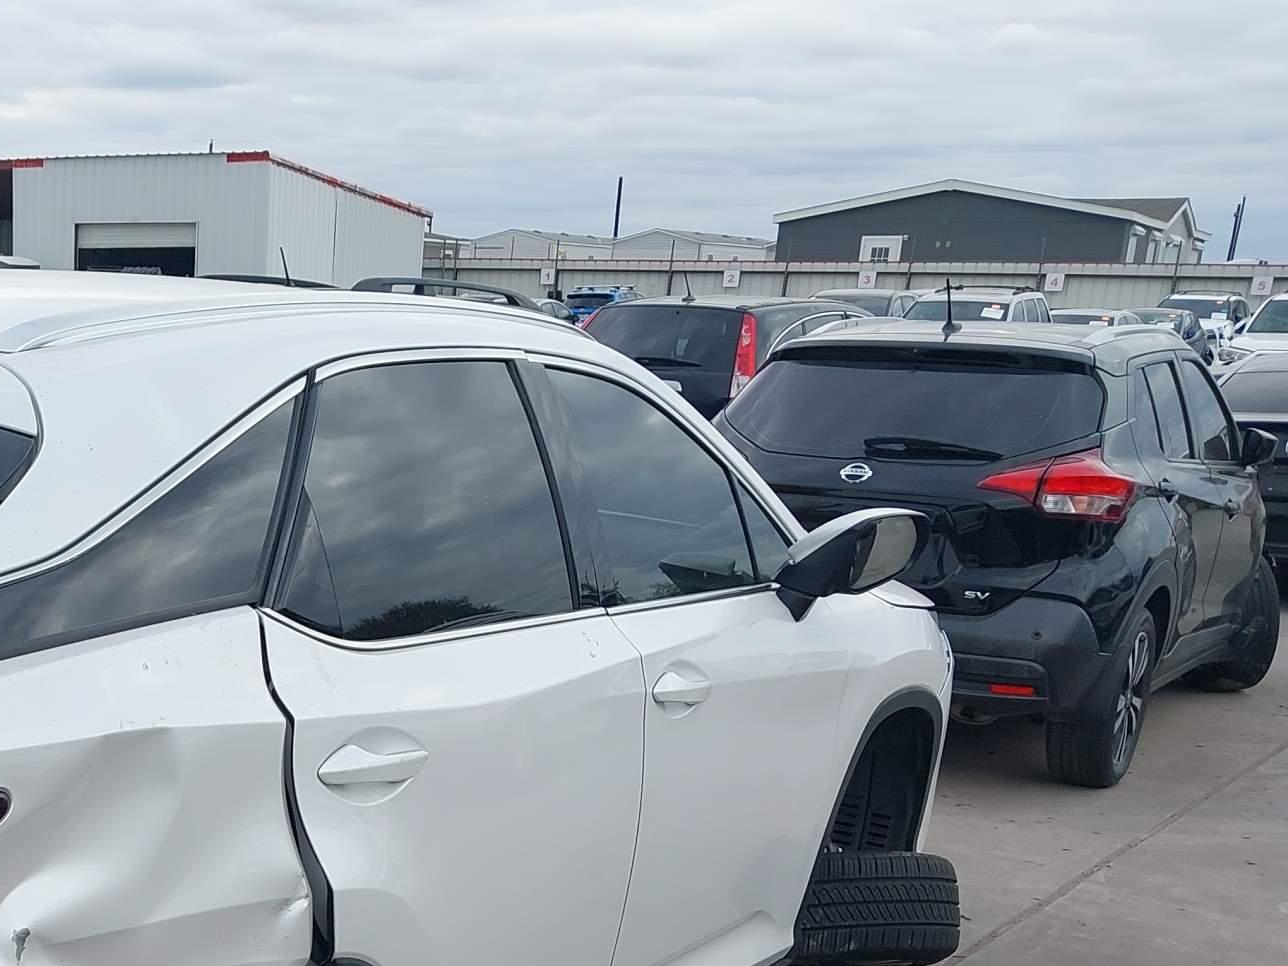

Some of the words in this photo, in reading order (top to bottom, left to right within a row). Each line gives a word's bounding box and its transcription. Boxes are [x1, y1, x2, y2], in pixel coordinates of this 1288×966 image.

[727, 274, 736, 283] 2
[863, 275, 871, 285] 3
[1257, 281, 1267, 291] 5
[964, 591, 991, 600] SV
